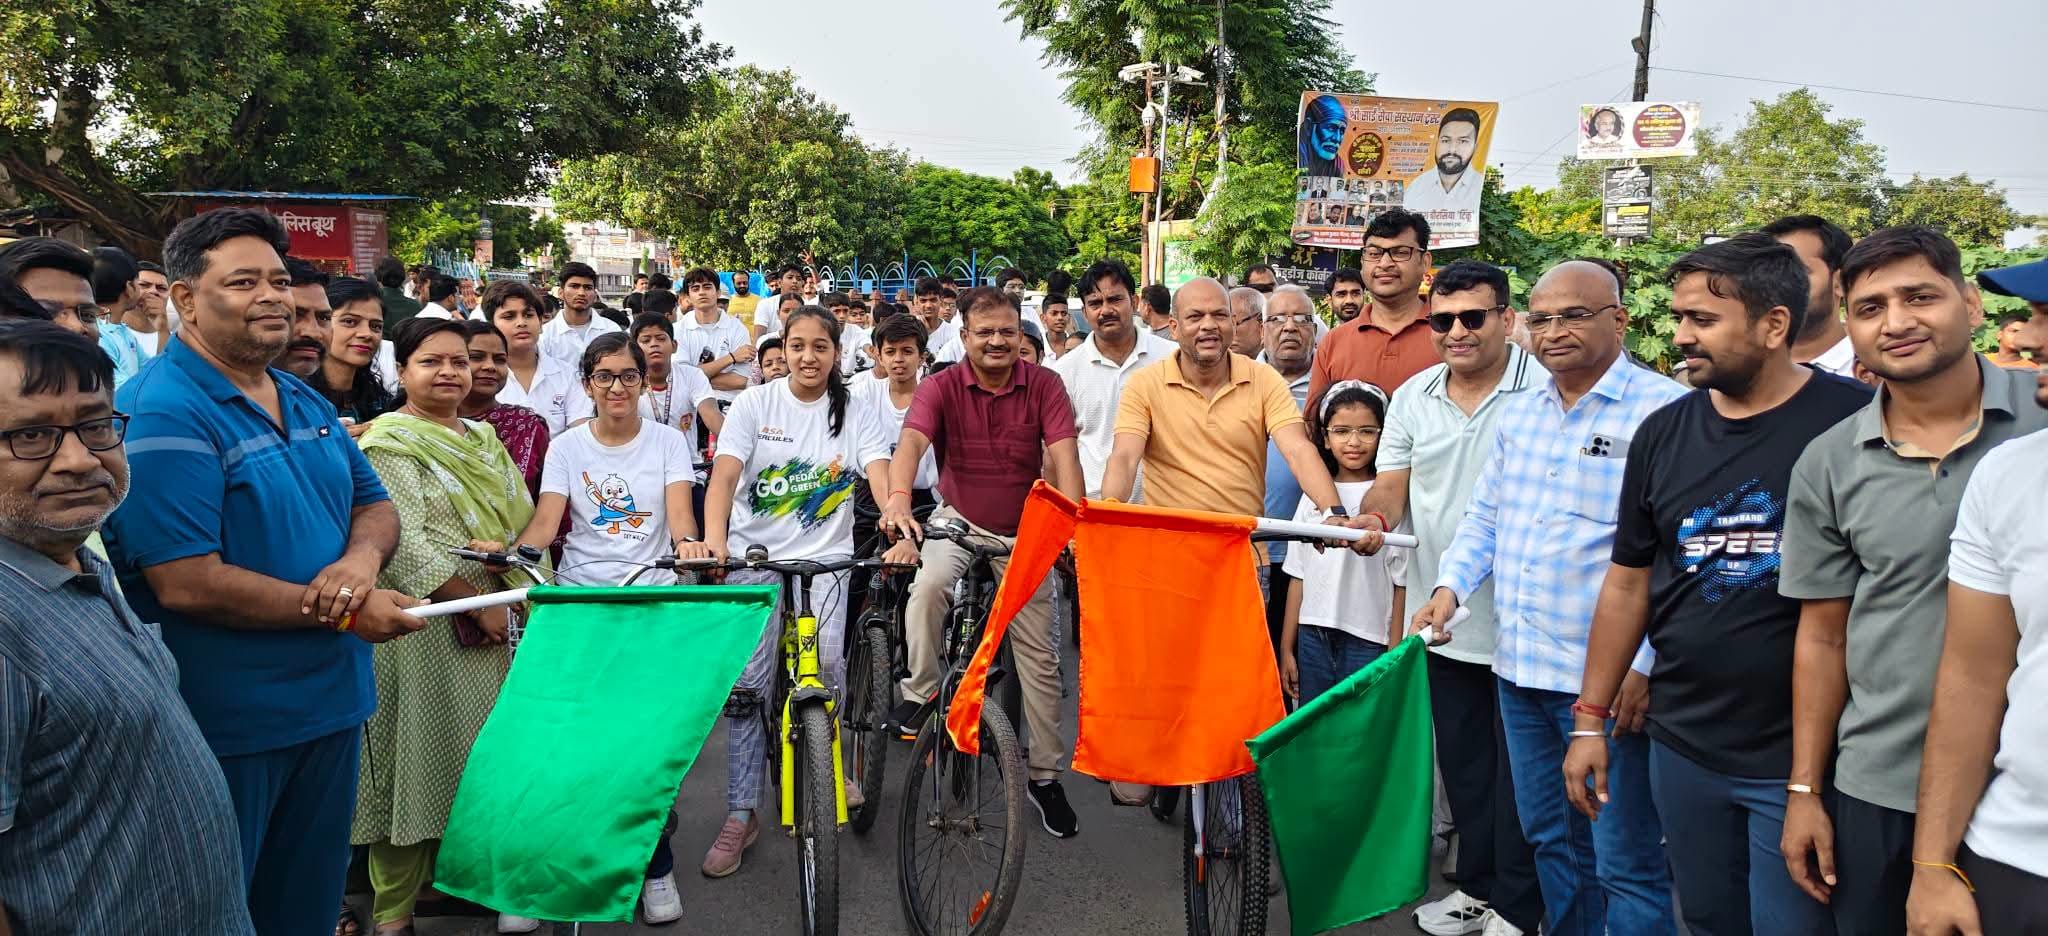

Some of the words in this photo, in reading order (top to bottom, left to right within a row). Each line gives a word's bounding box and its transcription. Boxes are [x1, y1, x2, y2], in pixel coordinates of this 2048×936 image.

[756, 433, 793, 442] ERCULES
[789, 471, 820, 483] PEDAL
[756, 476, 789, 498] GO
[790, 481, 820, 493] GREEN
[1681, 530, 1782, 557] SPEE
